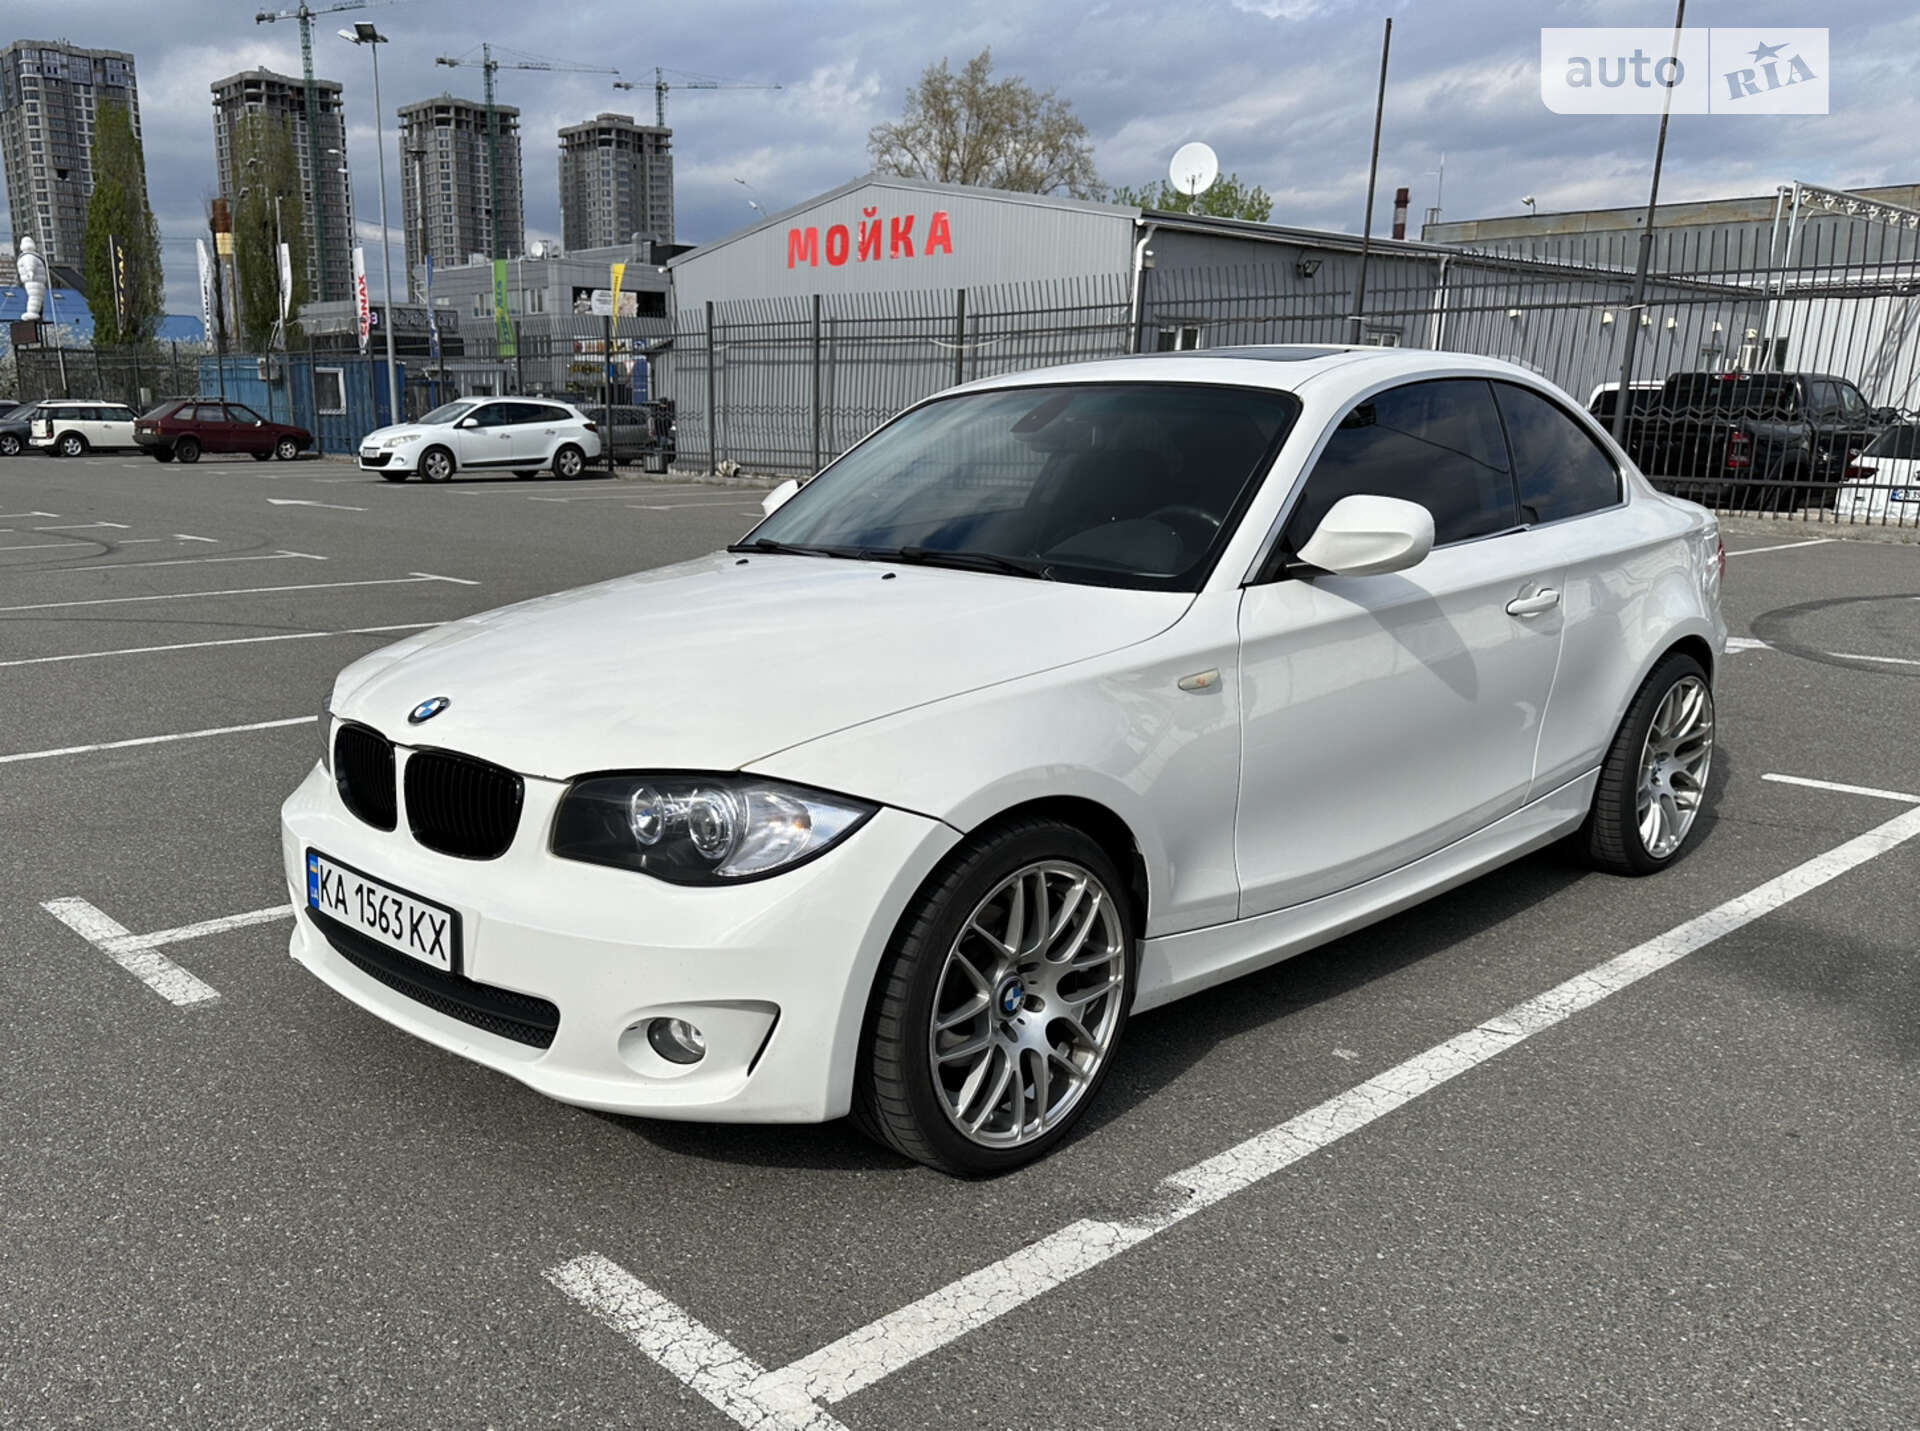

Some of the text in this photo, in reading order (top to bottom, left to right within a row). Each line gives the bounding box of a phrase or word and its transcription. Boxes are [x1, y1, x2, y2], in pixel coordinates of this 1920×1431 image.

[787, 205, 953, 270] МОЙКА
[358, 274, 370, 337] SONAX
[320, 865, 447, 961] KA 1563 KX
